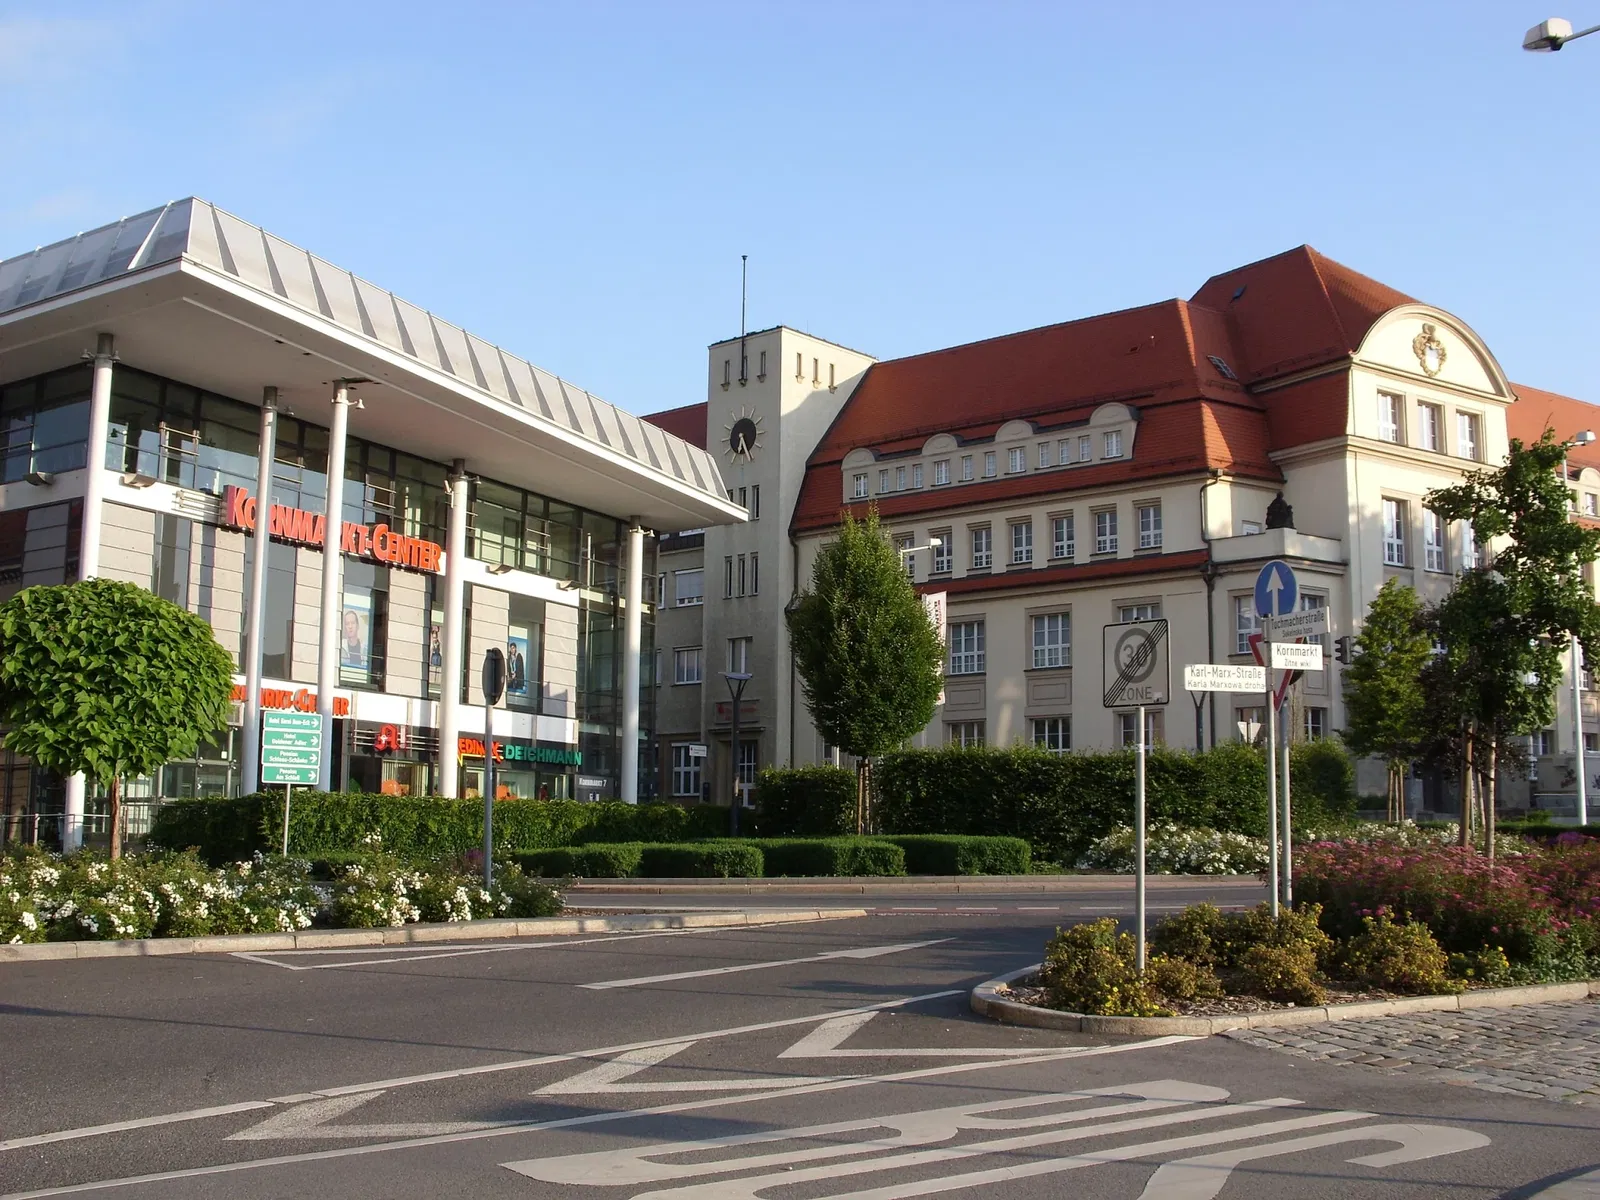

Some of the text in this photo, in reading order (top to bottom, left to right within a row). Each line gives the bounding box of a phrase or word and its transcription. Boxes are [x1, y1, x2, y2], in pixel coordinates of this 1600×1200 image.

[224, 484, 441, 572] KORNMAKT-CENTER
[1270, 610, 1325, 630] Tuchmacherstraße
[1276, 644, 1318, 657] Kornmarkt
[1190, 665, 1262, 679] Karl-Marx-Straße
[1187, 680, 1207, 688] Karla
[1210, 680, 1242, 689] Marxowa
[1119, 686, 1153, 701] ZONE
[505, 744, 582, 766] DEICHMANN
